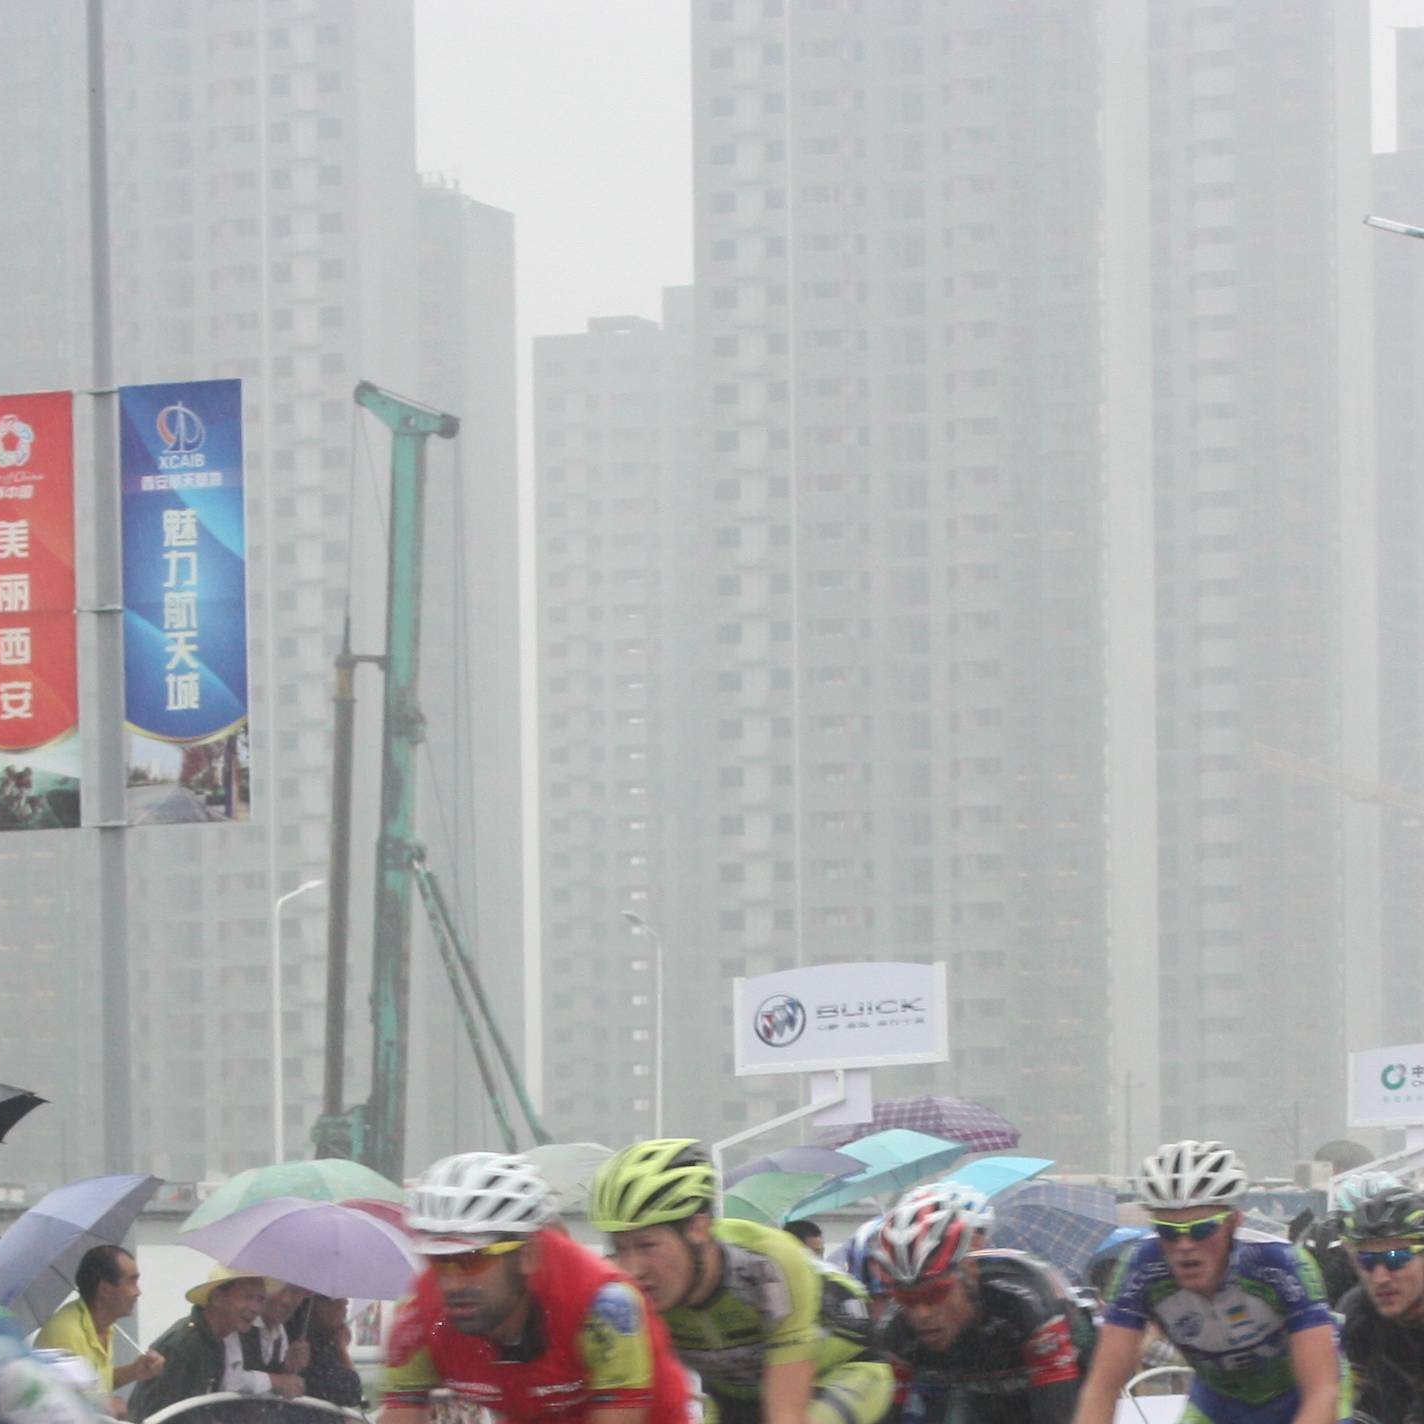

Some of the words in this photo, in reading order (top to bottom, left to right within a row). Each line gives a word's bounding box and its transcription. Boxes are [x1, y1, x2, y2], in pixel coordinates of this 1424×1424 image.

[161, 509, 200, 712] 魅力航天城
[816, 997, 927, 1020] BUICK
